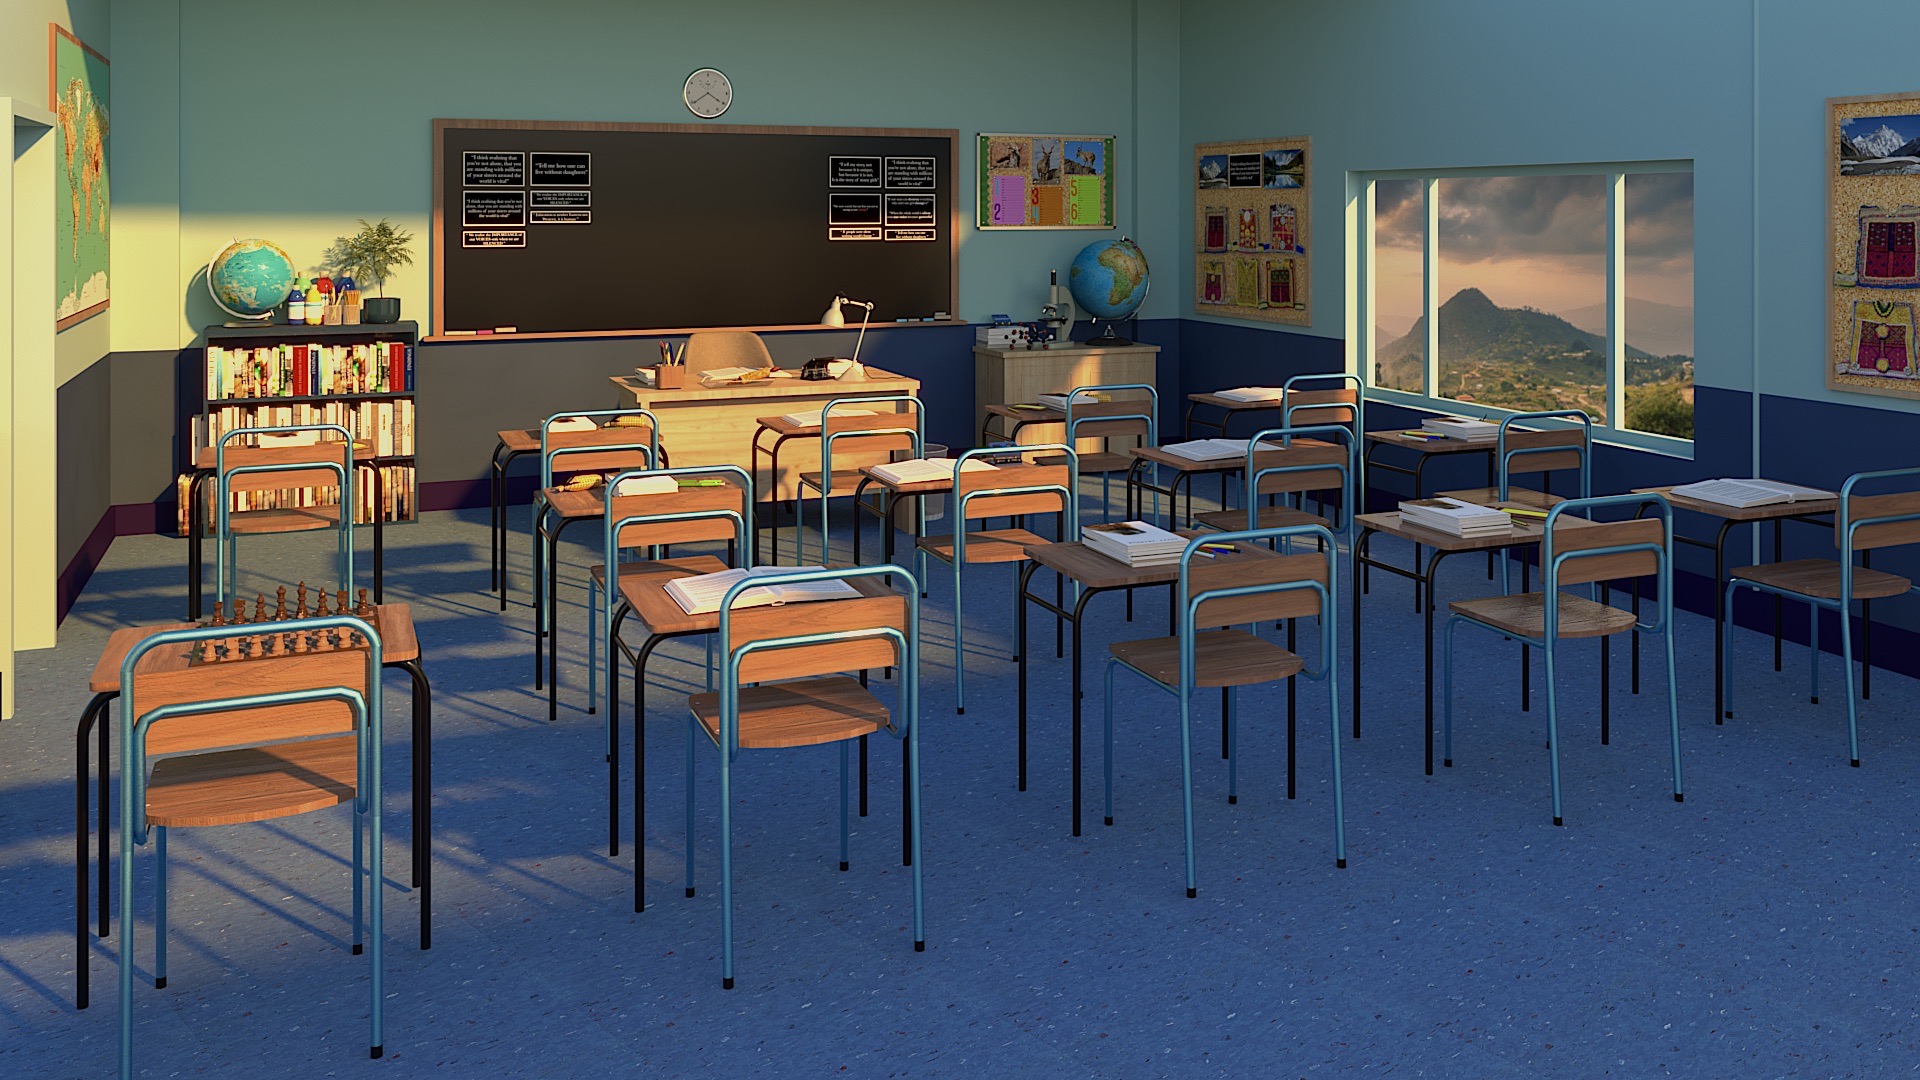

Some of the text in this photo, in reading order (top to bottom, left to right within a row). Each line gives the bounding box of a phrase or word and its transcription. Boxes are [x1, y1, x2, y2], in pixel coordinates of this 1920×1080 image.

[1071, 180, 1077, 196] 5
[1032, 188, 1038, 205] 3
[995, 203, 1000, 220] 2
[1071, 204, 1077, 220] 6
